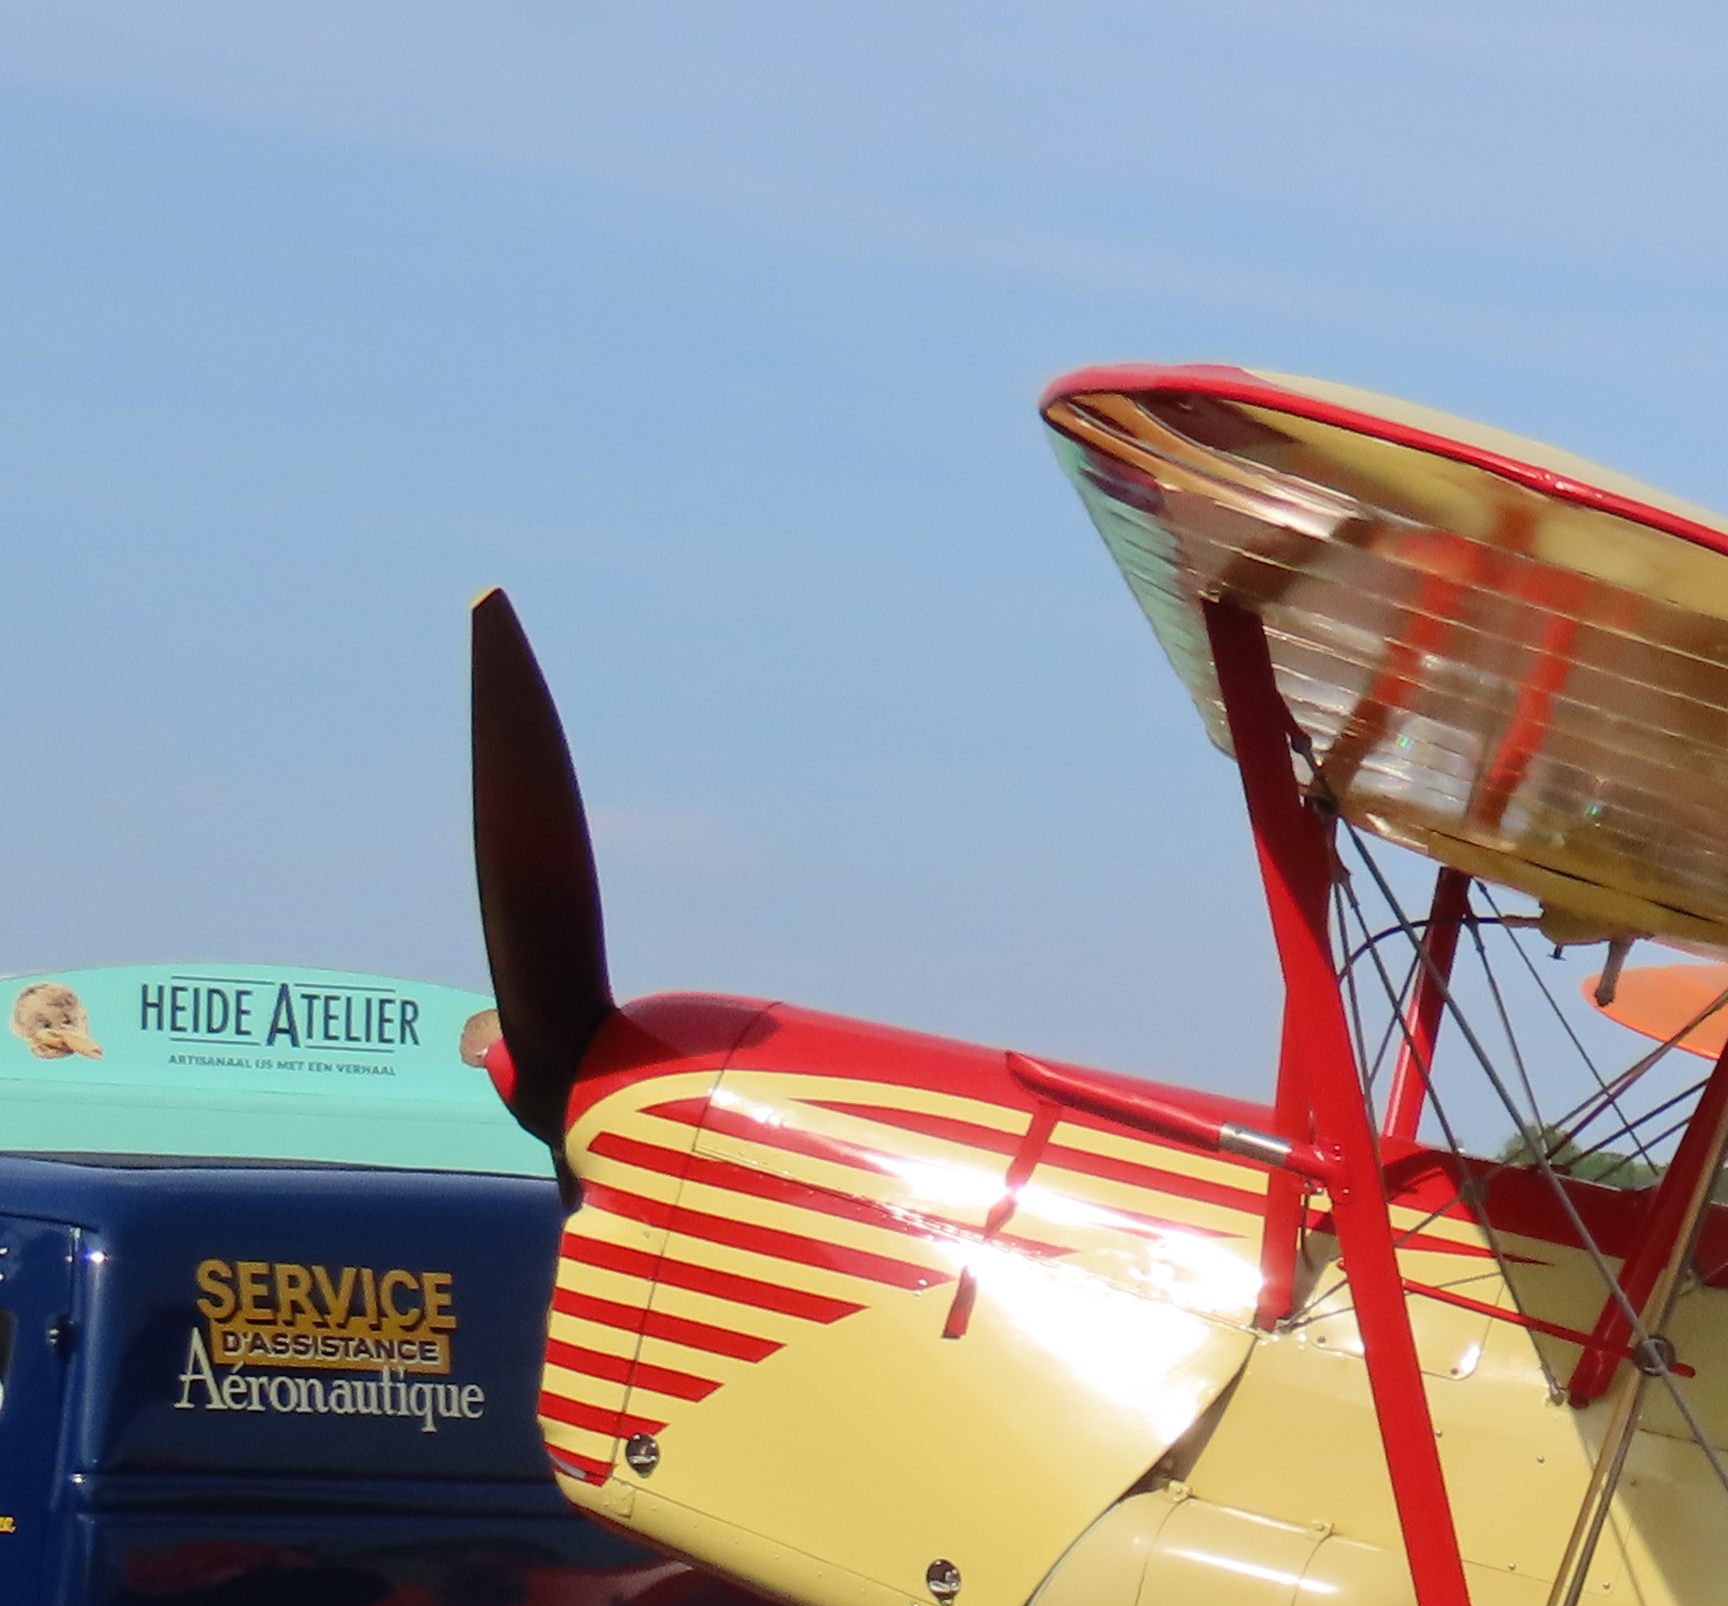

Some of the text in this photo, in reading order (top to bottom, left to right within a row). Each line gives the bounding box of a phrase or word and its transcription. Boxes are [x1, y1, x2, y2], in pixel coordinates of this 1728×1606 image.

[140, 983, 421, 1048] HEIDE ATELIER
[168, 1054, 251, 1070] ARTISANAAL
[277, 1060, 304, 1072] MET
[308, 1061, 333, 1073] EEN
[335, 1062, 397, 1077] VERHAAL
[196, 1258, 457, 1332] SERVICE
[173, 1326, 486, 1433] Aéronautique
[222, 1330, 441, 1365] D'ASSISTANCE
